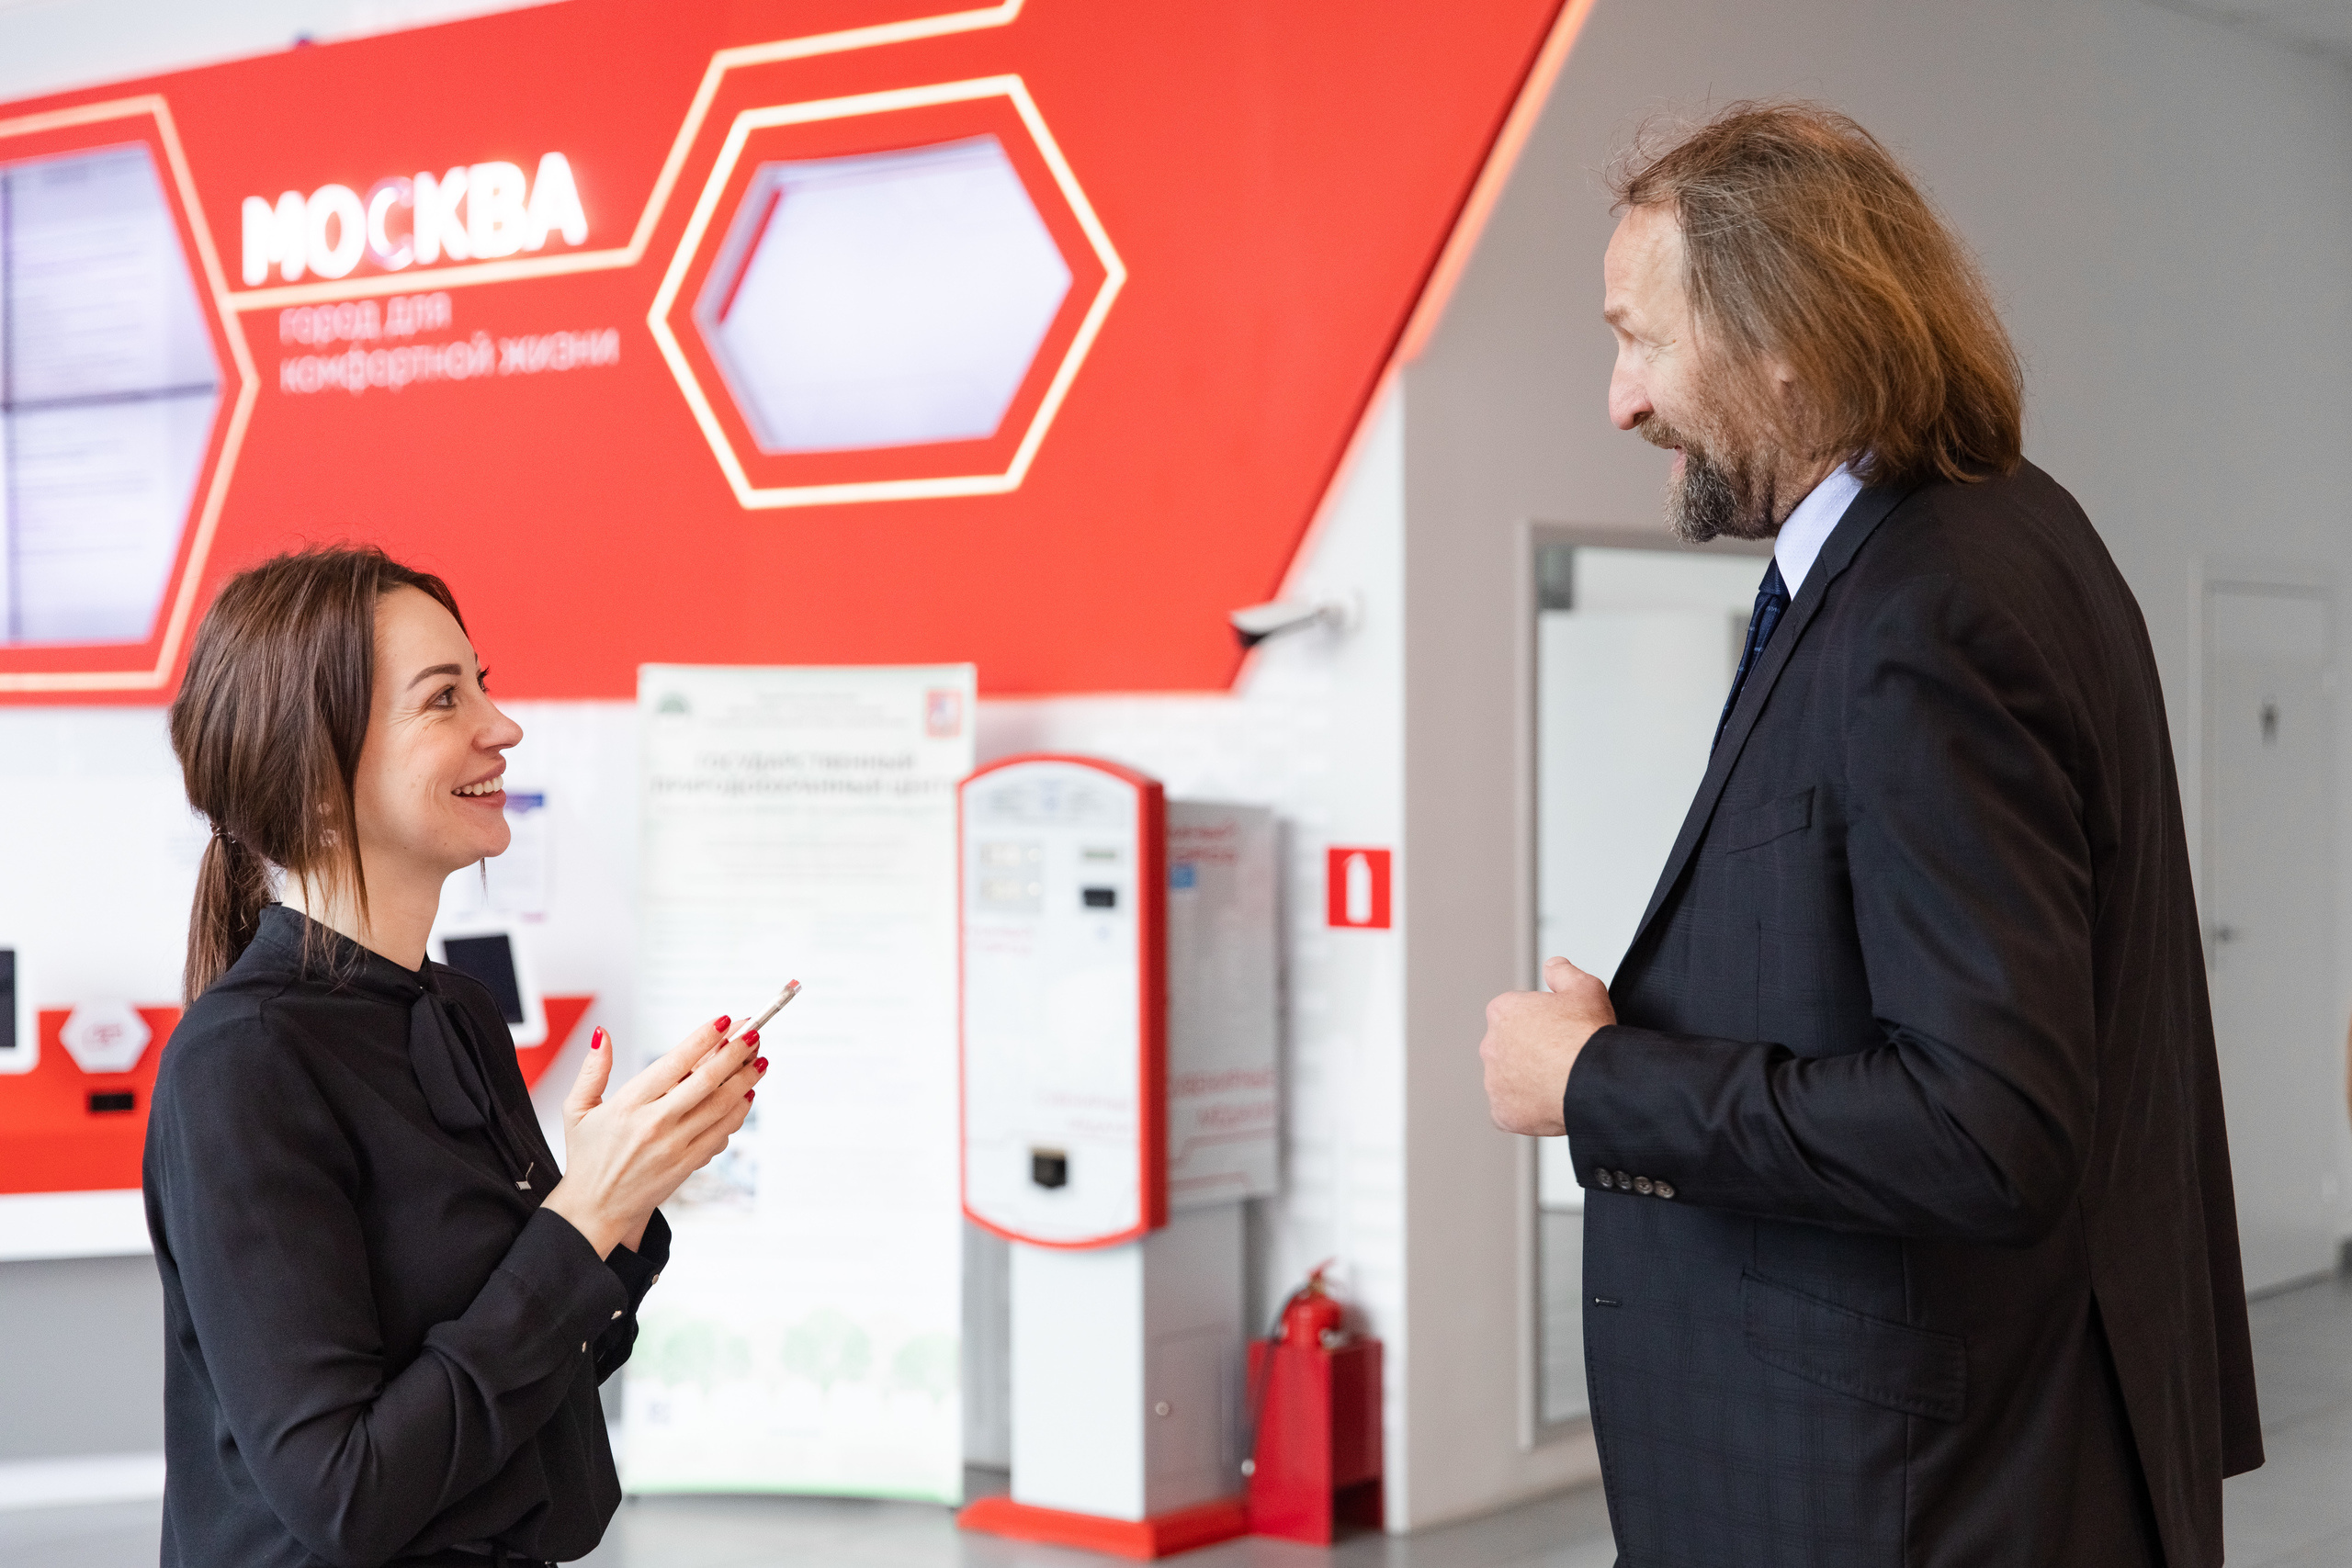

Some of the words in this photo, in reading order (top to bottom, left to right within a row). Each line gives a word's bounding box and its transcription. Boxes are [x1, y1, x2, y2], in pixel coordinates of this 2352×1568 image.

[242, 152, 588, 287] МОСКВА
[279, 300, 381, 348] город
[384, 292, 452, 340] для
[279, 331, 495, 395] комфортной
[499, 328, 620, 376] жизни
